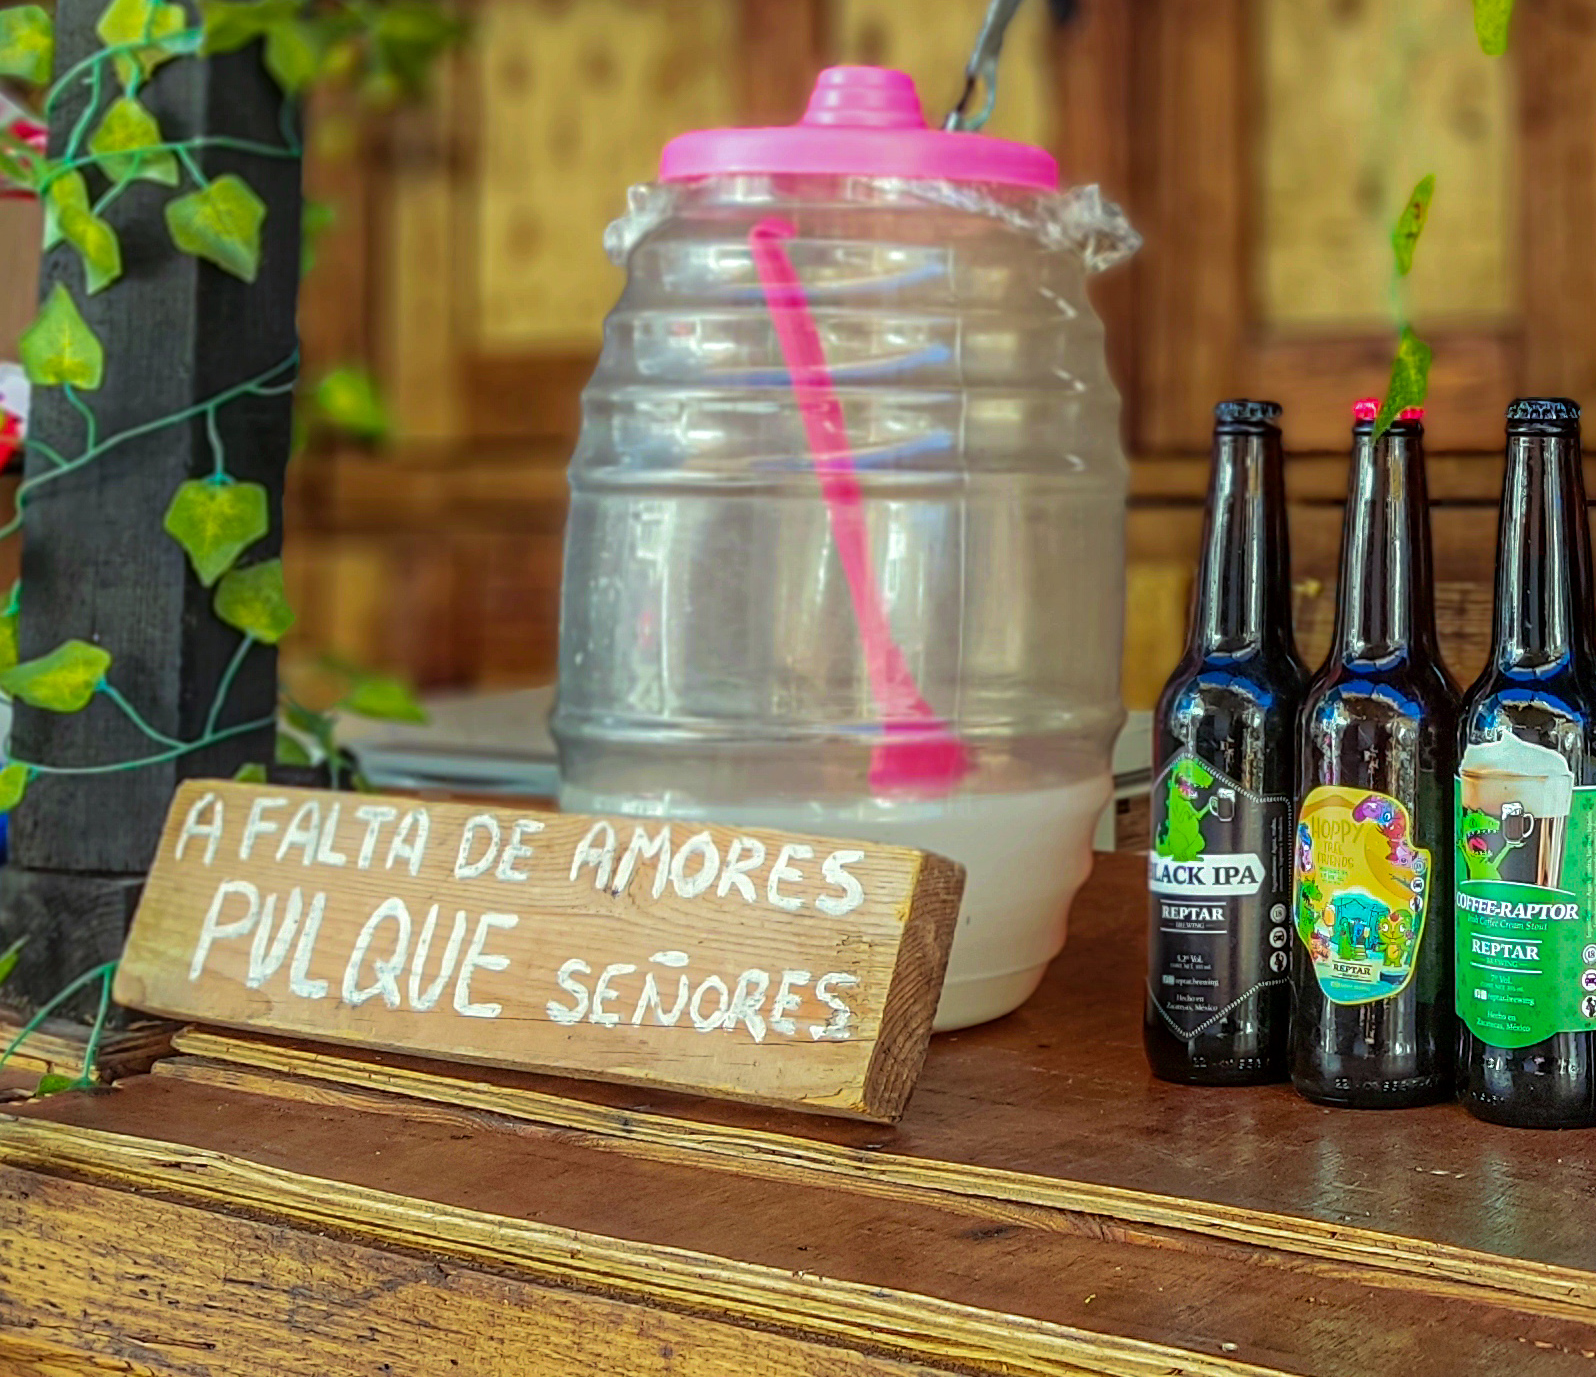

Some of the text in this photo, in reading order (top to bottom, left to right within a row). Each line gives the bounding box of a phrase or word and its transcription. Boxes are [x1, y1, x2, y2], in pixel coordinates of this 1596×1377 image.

[1311, 815, 1365, 844] HOPPY
[175, 791, 869, 917] A FALTA DE AMORES
[1150, 863, 1261, 886] LACK IPA
[1161, 905, 1226, 921] REPTAR
[1456, 891, 1580, 920] COFFEE-RAPTOR
[187, 878, 862, 1044] PULQUE SEÑORES
[1471, 938, 1541, 960] REPTAR
[1333, 964, 1371, 976] REPTAR
